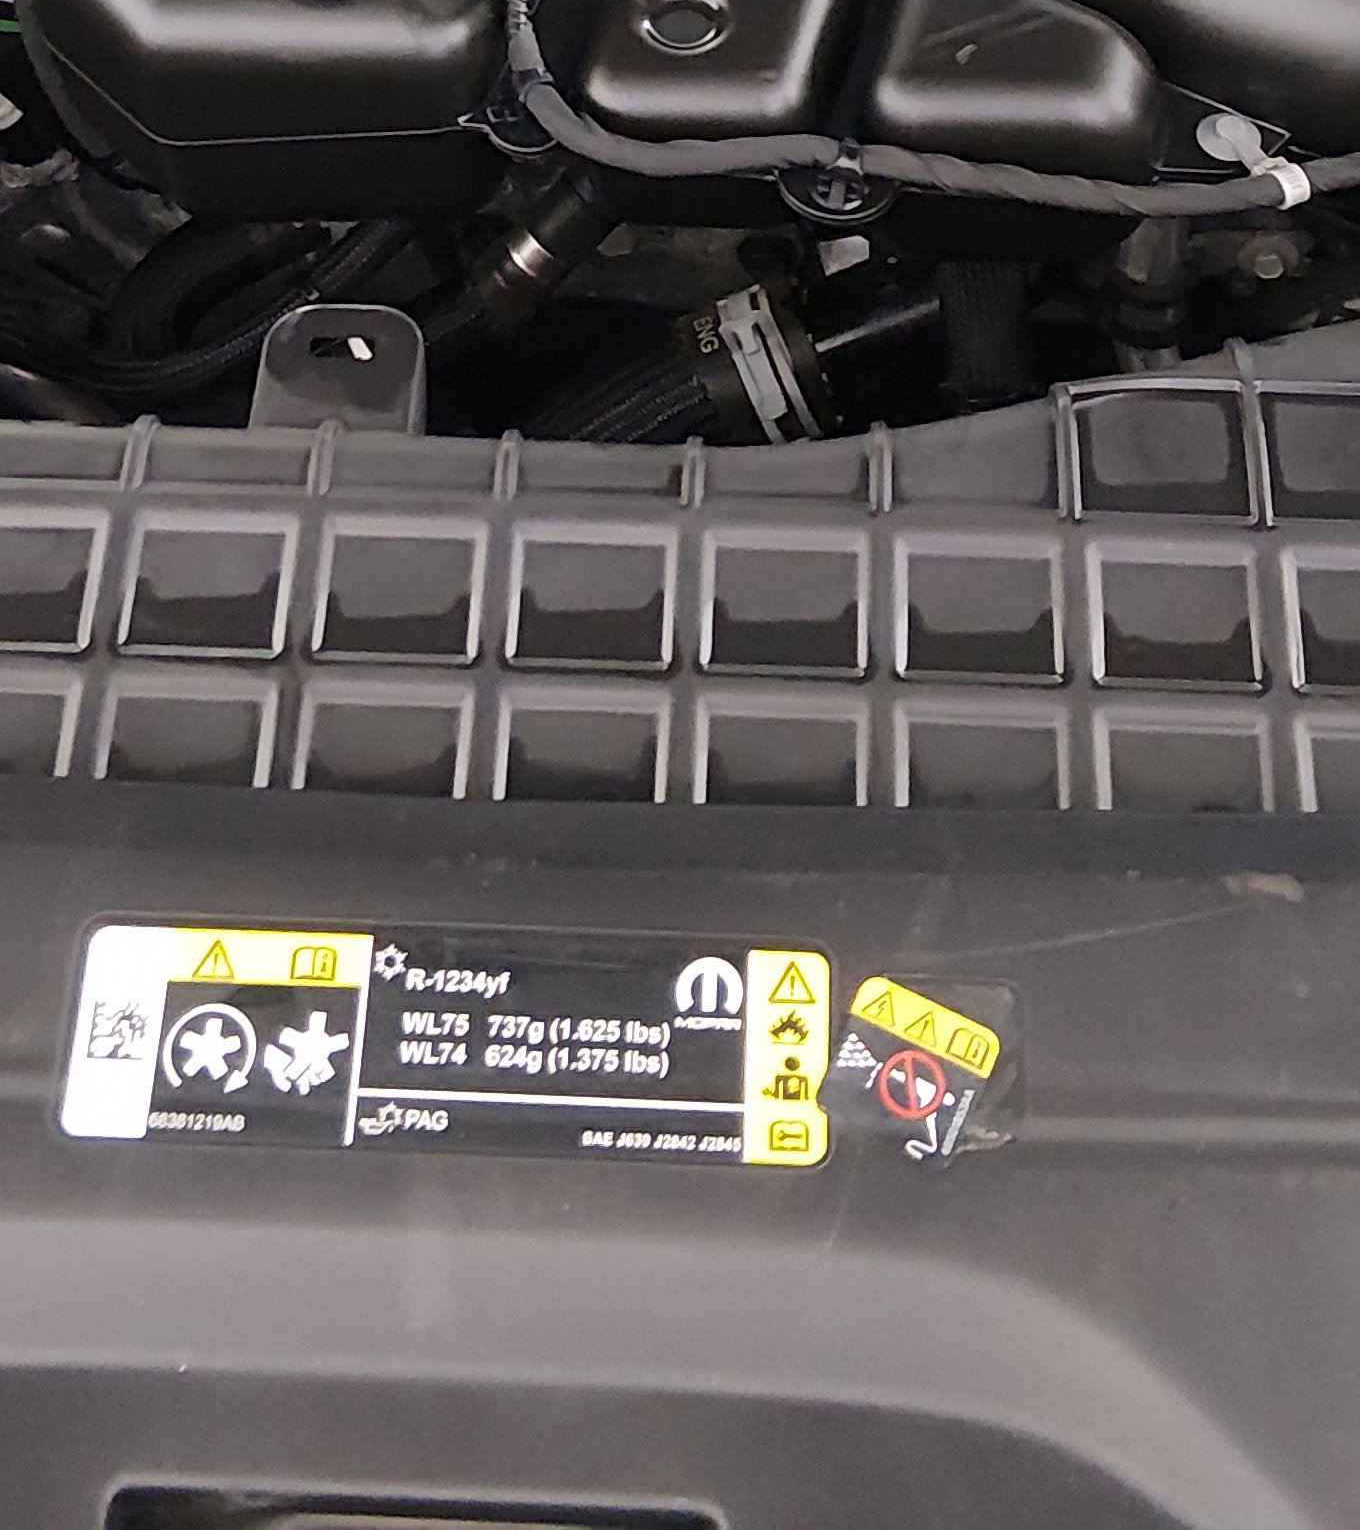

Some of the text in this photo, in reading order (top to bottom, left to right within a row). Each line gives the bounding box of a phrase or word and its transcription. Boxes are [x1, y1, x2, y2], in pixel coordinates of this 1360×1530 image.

[693, 315, 720, 354] ENG
[404, 968, 512, 998] R-1234yf
[402, 1011, 671, 1048] WL75 737g (1.625 lbs)
[399, 1041, 670, 1079] WL74 624g (1.375 lbs)
[402, 1109, 449, 1132] PAG
